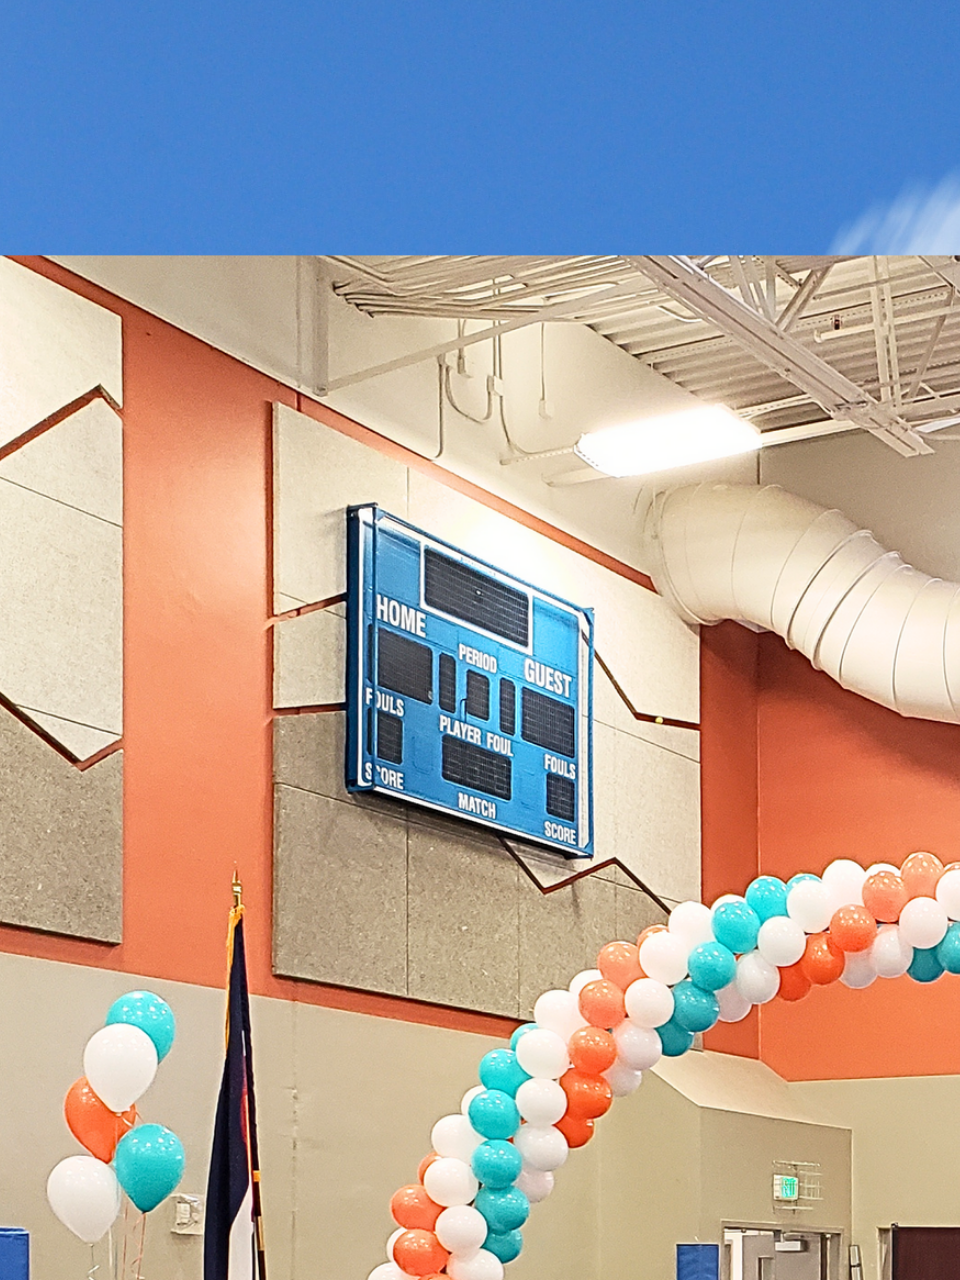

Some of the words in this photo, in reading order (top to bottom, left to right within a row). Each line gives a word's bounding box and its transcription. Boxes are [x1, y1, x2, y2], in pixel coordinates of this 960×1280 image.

[376, 594, 426, 637] HOME
[458, 643, 497, 674] PERIOD
[523, 659, 573, 698] GUEST
[439, 715, 482, 746] PLAYER
[486, 731, 514, 757] FOUL
[544, 754, 576, 779] FOULS
[458, 793, 496, 819] MATCH
[544, 821, 576, 845] SCORE
